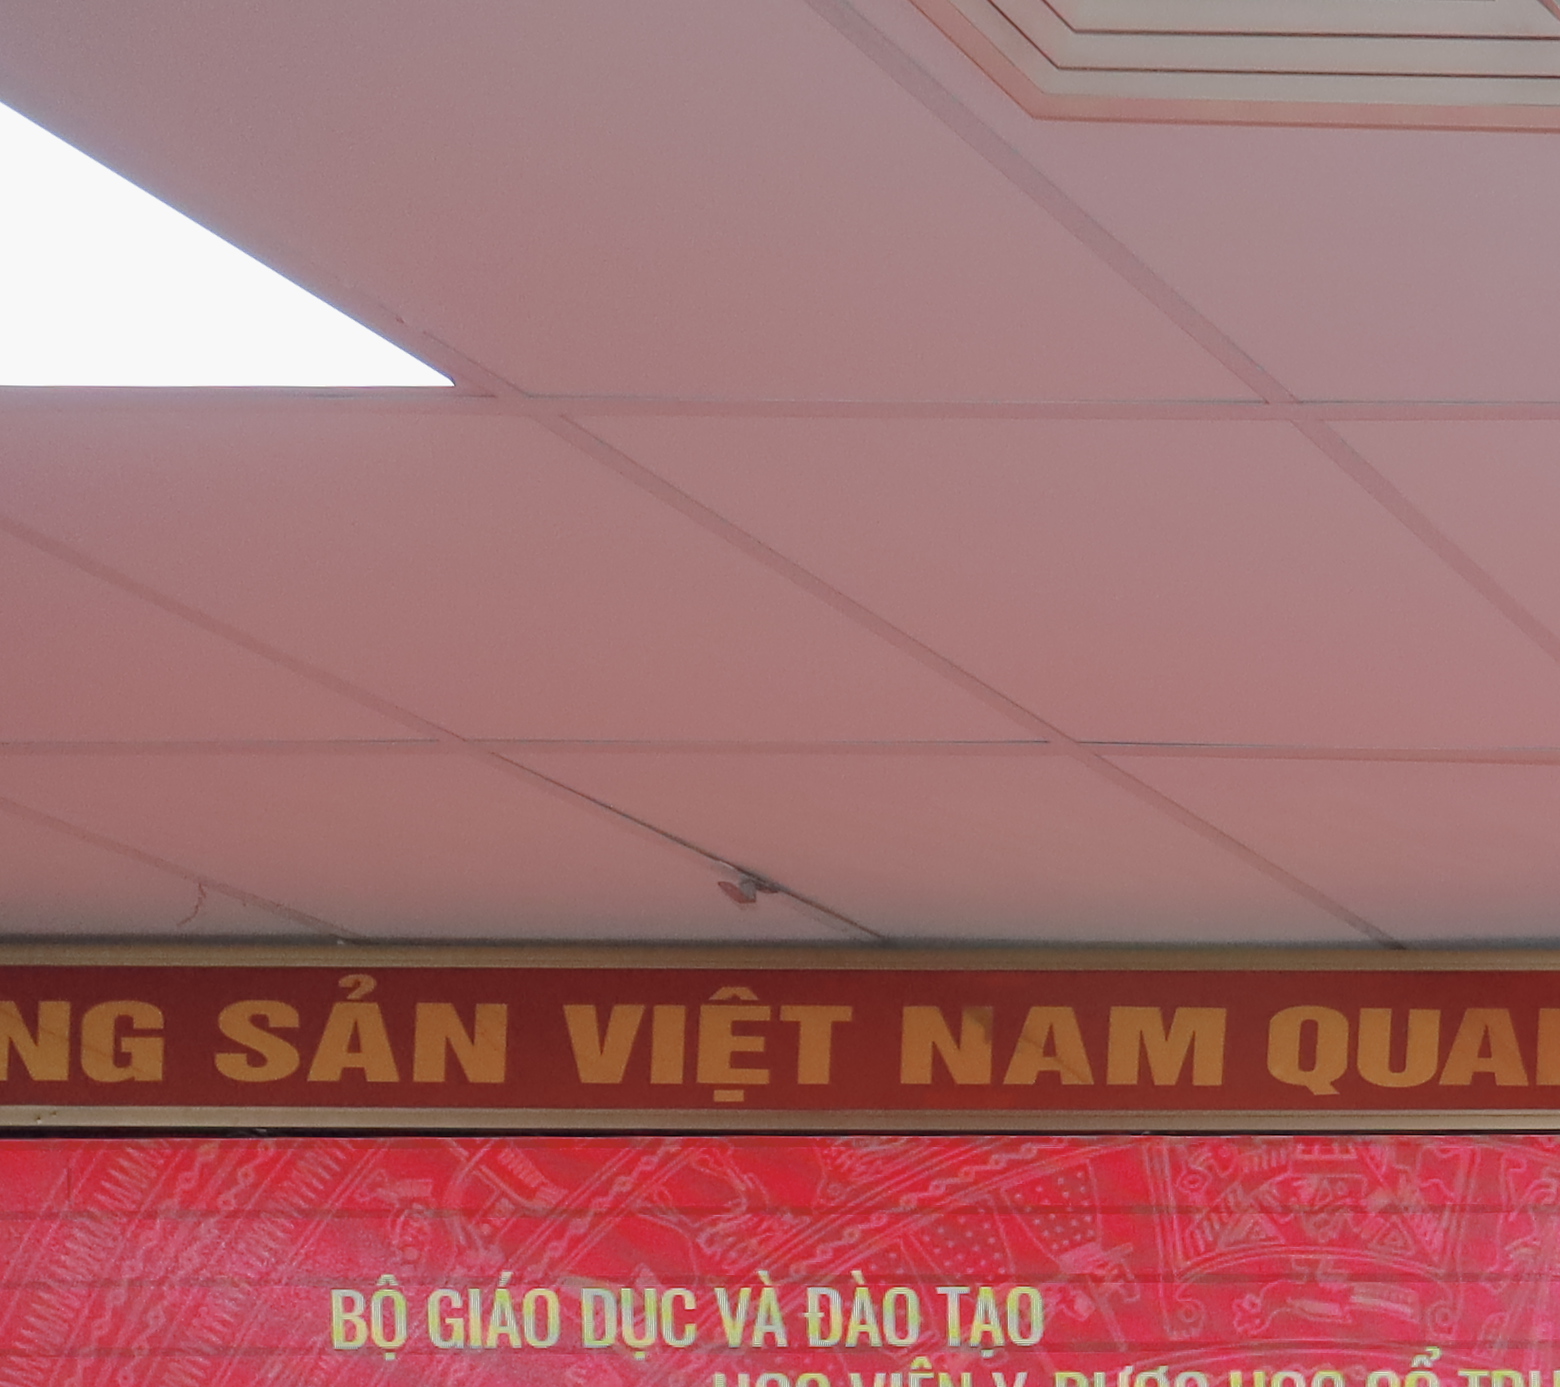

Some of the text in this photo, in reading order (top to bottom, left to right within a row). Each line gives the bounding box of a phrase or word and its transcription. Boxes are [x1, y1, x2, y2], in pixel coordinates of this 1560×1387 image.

[216, 977, 507, 1083] SẢN
[565, 988, 852, 1102] VIỆT
[902, 1006, 1227, 1086] NAM
[332, 1270, 1044, 1361] BỘ GIÁO DỤC VÀ ĐÀO TẠO
